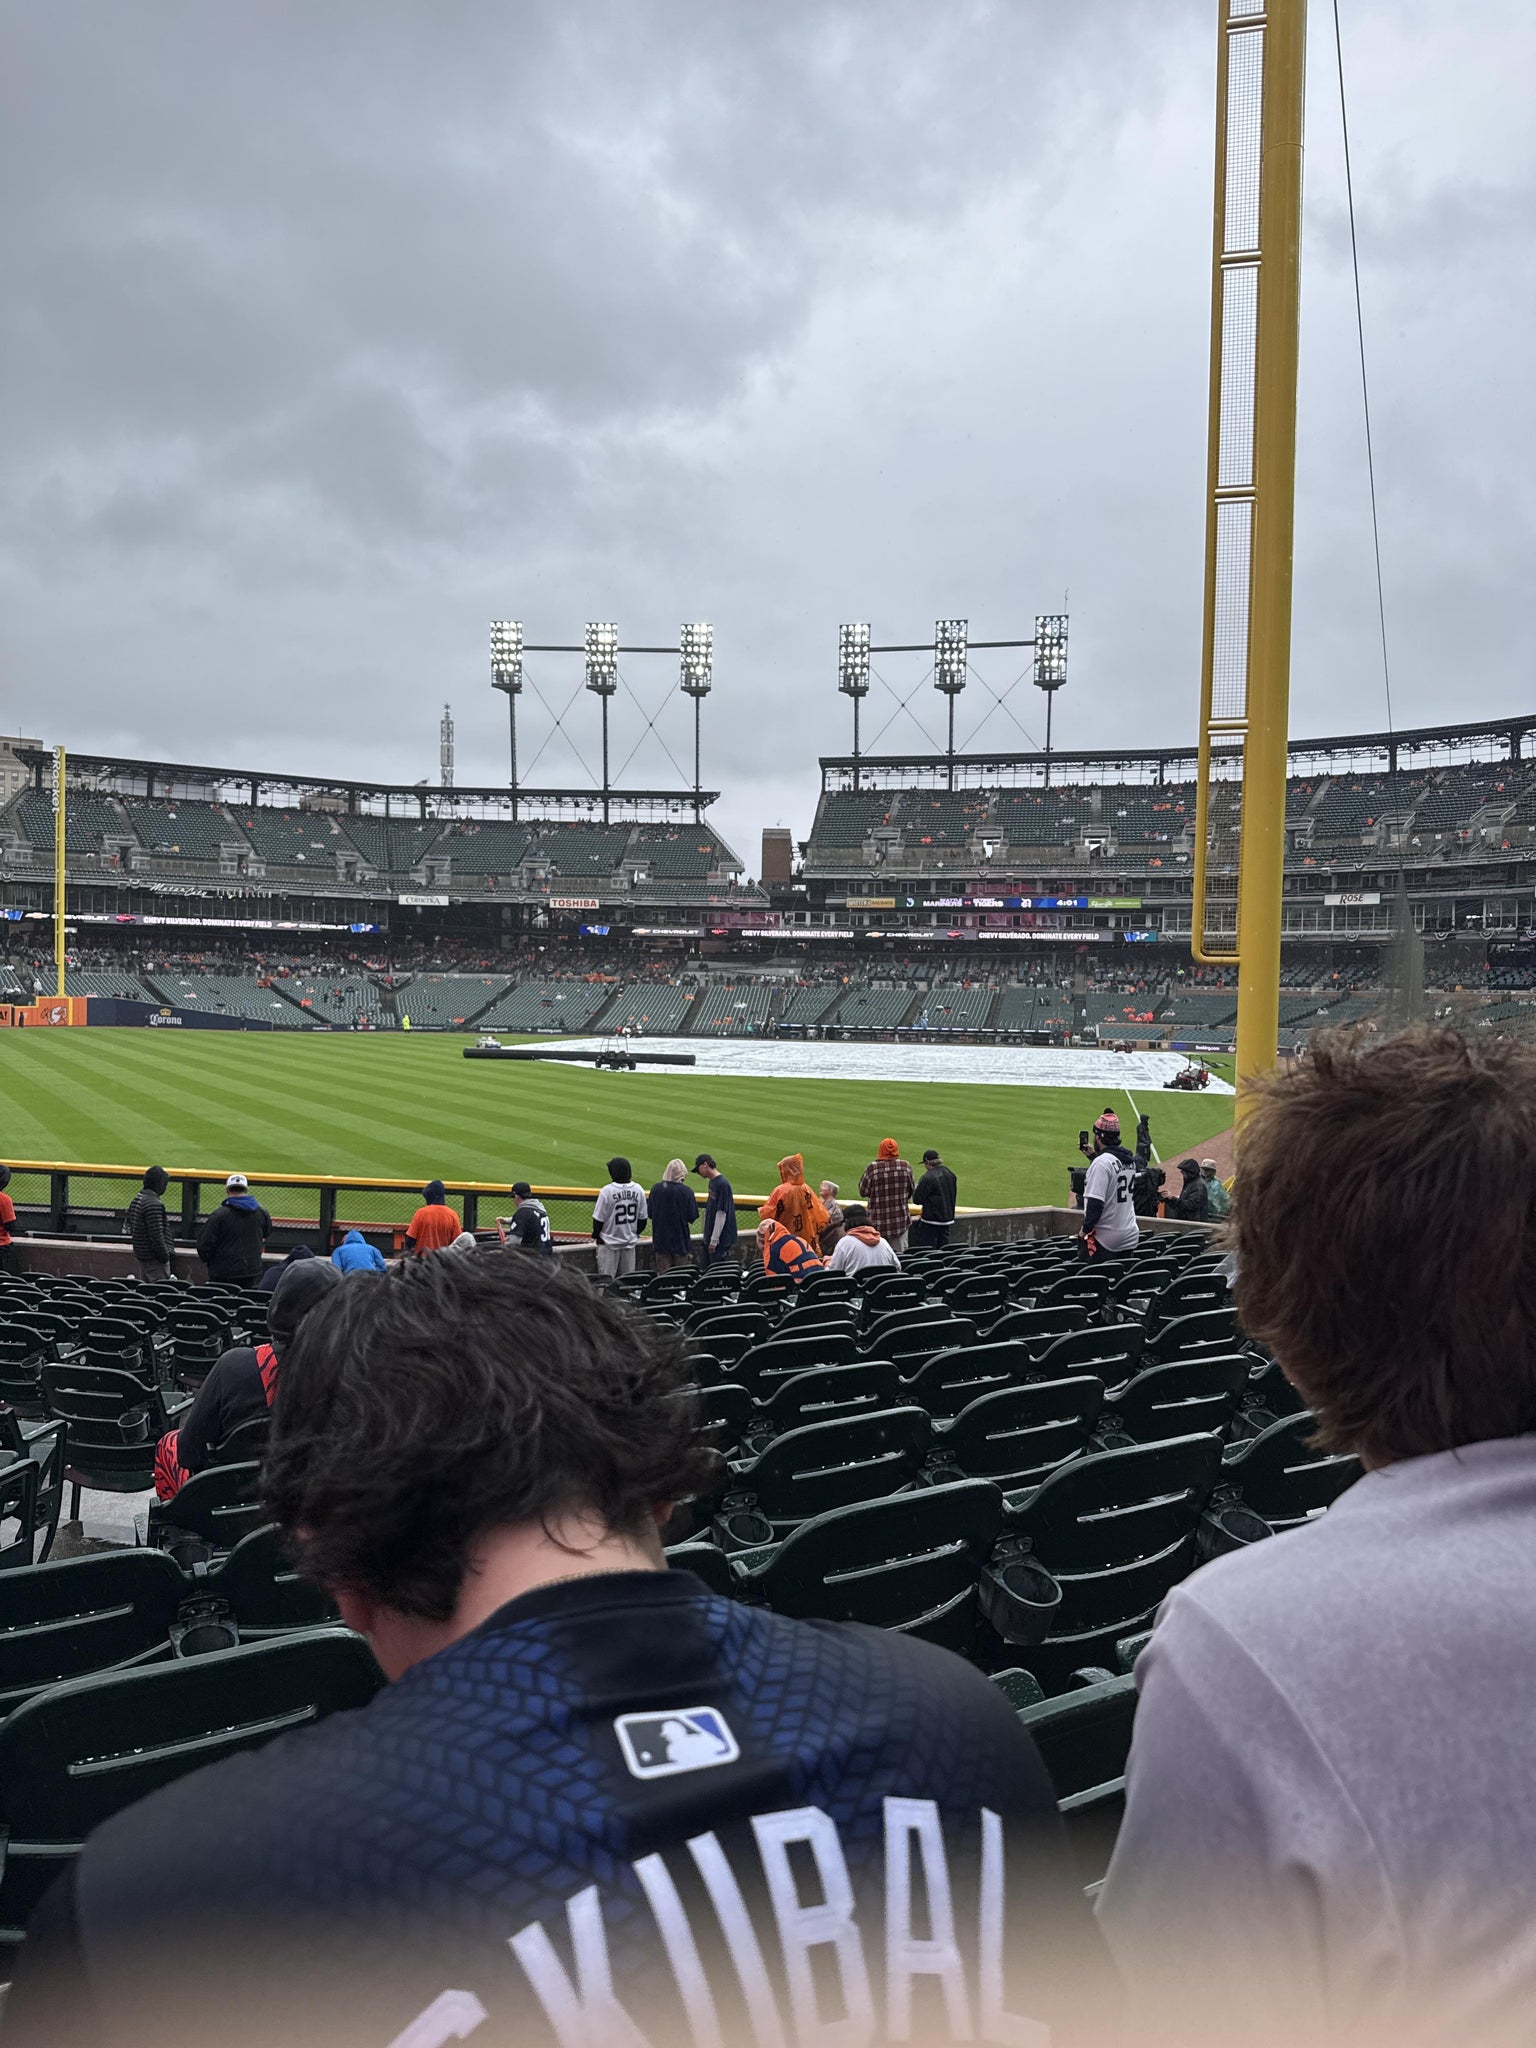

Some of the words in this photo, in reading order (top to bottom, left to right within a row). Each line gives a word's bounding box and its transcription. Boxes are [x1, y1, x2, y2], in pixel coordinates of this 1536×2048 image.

[551, 899, 597, 908] TOSHIBA
[1340, 894, 1364, 904] ROSE
[143, 916, 165, 924] CHEVY
[202, 918, 235, 927] DOMINATE
[235, 920, 255, 928] EVERY
[1032, 932, 1062, 940] DOMINATE
[150, 1014, 182, 1026] Corona
[1117, 1175, 1136, 1203] 24
[612, 1190, 639, 1203] SKUBAL
[615, 1203, 638, 1225] 29
